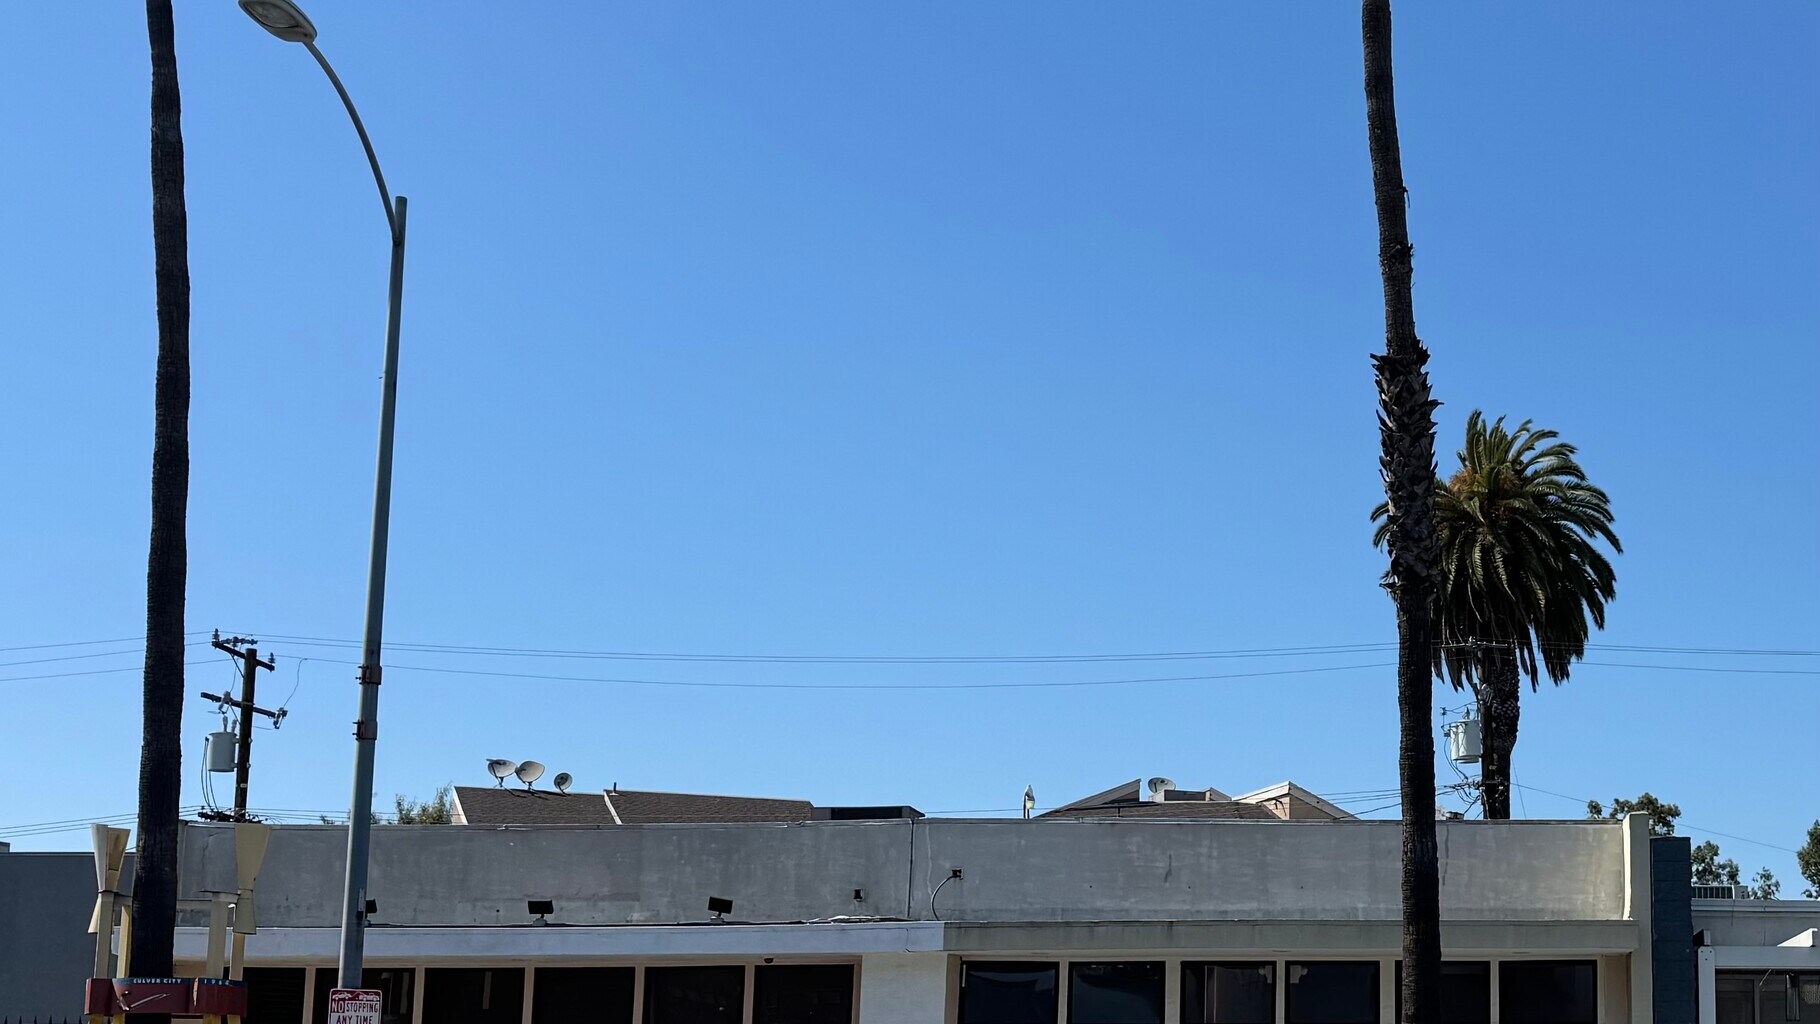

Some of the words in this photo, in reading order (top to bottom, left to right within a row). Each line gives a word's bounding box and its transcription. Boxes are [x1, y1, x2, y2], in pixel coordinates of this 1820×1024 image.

[332, 1000, 345, 1013] NO
[346, 1002, 379, 1013] STOPPING
[336, 1015, 352, 1024] ANY
